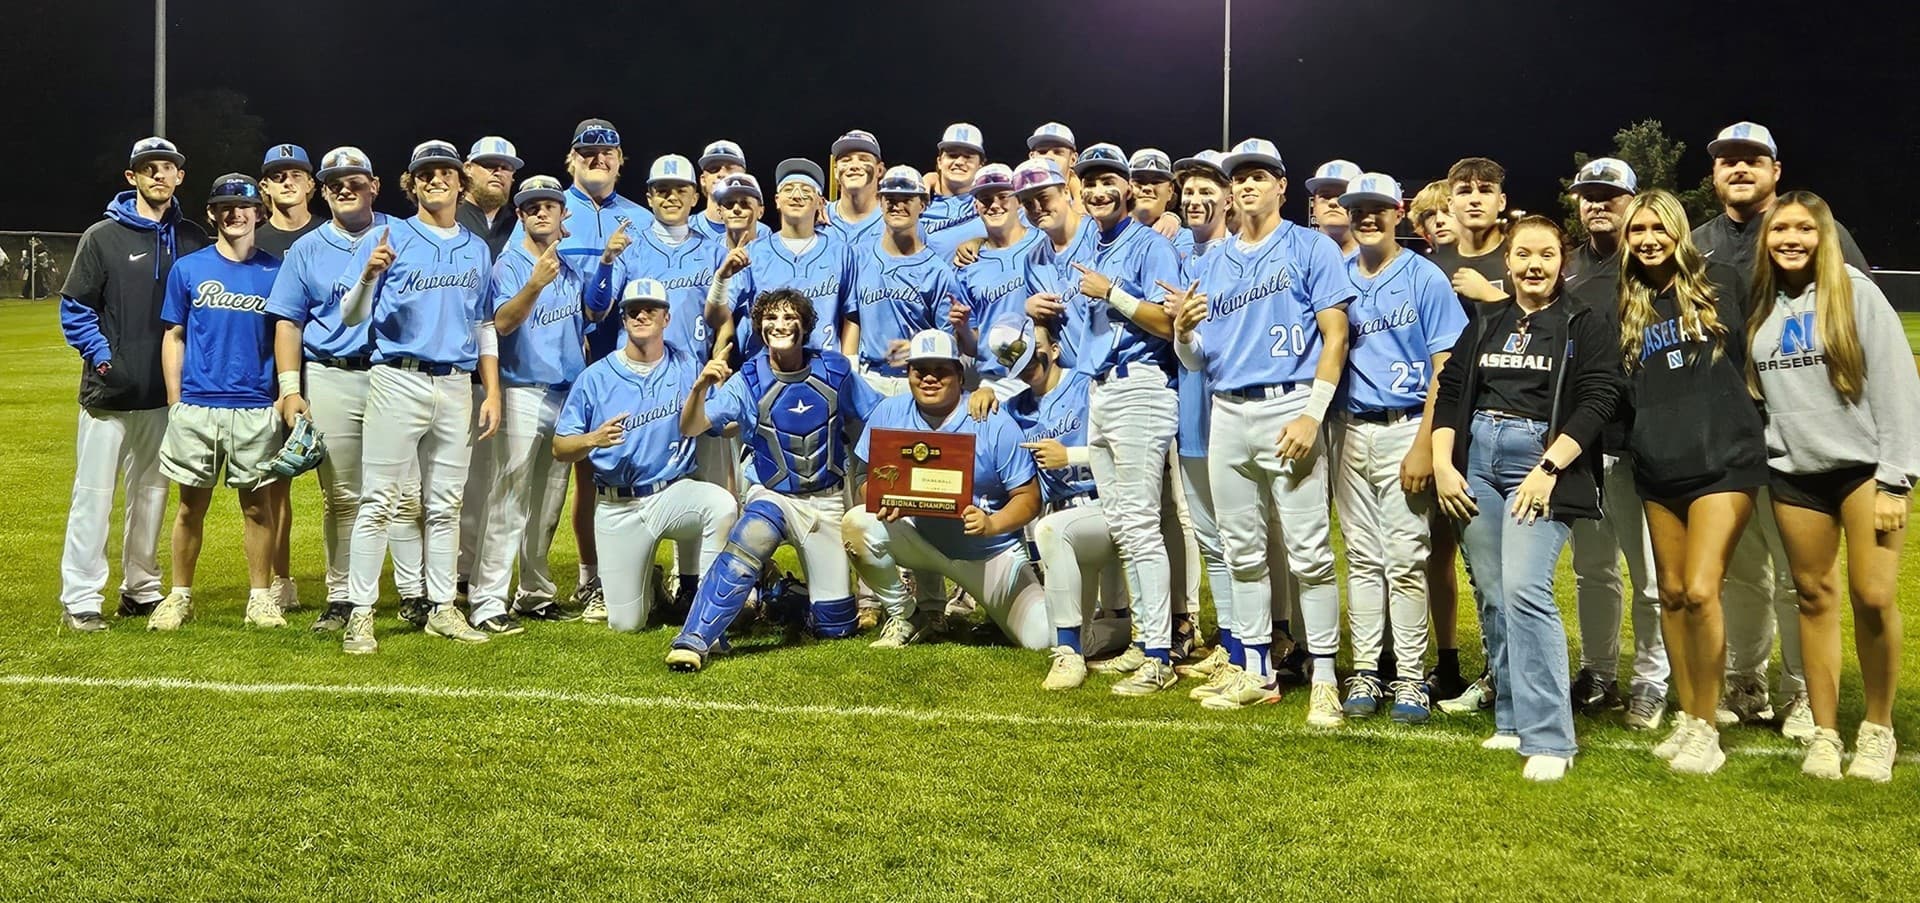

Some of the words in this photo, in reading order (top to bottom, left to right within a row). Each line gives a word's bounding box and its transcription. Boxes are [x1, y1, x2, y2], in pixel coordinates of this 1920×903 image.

[956, 128, 968, 140] N
[280, 145, 294, 158] N
[664, 160, 677, 175] N
[1361, 177, 1376, 192] N
[398, 267, 480, 294] Newcastle
[637, 281, 651, 295] N
[1207, 265, 1292, 322] Newcastle
[1269, 324, 1306, 357] 20
[1781, 311, 1816, 356] N
[922, 338, 935, 353] N
[1479, 353, 1553, 371] ASEBALL
[1667, 350, 1684, 369] N
[1758, 354, 1827, 372] BASEBA
[1390, 361, 1427, 394] 27
[881, 498, 917, 508] REGIONAL
[918, 501, 956, 511] CHAMPION
